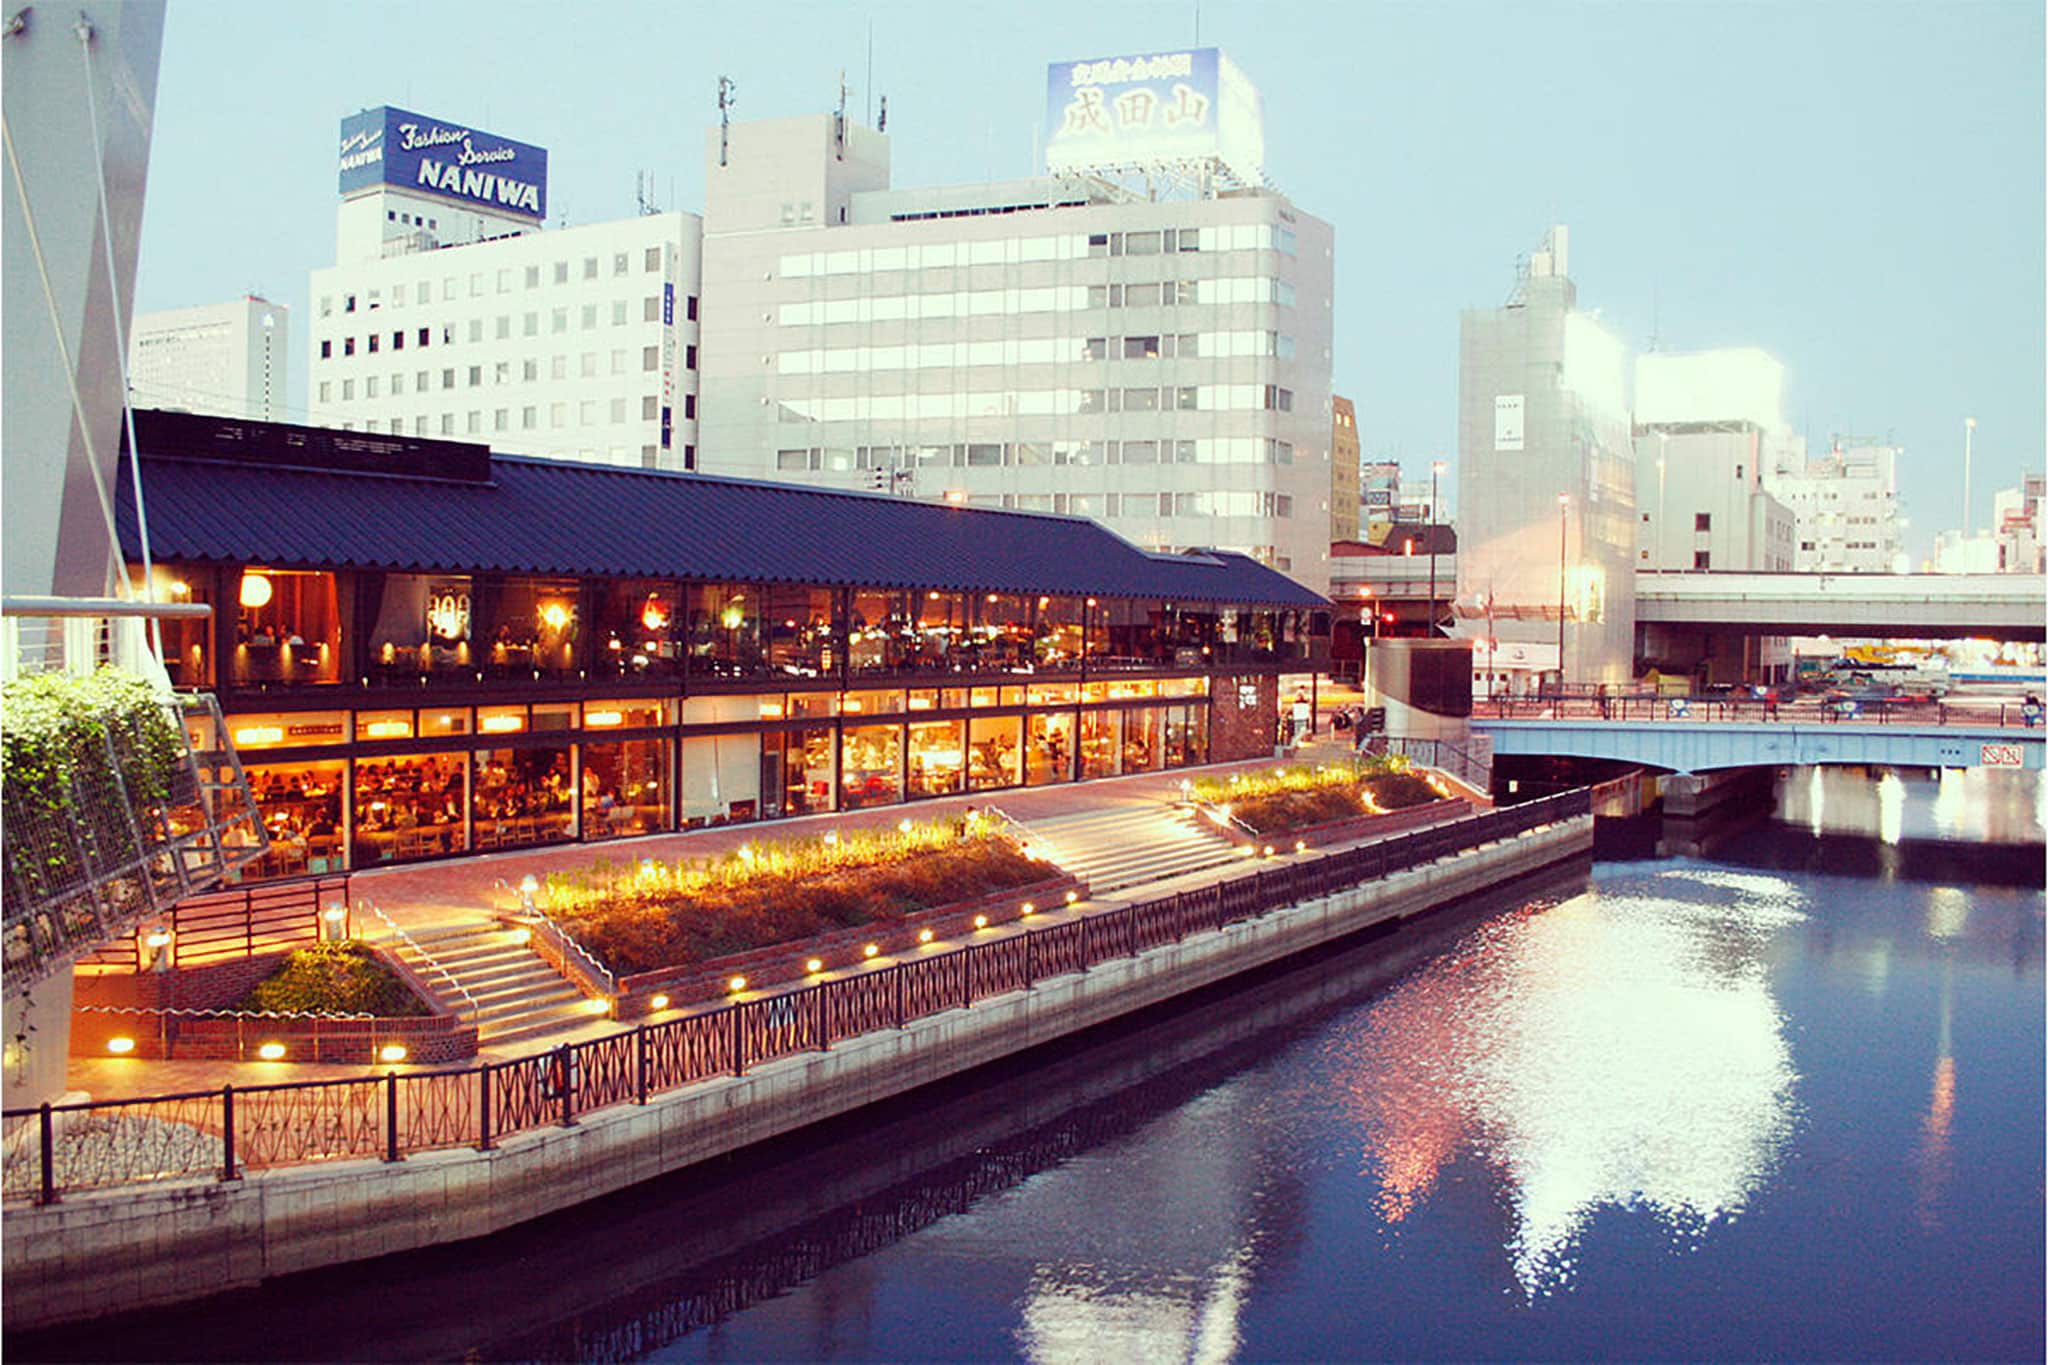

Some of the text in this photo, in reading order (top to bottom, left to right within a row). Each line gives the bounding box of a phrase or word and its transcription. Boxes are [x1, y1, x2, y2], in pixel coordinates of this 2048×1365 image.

[1060, 83, 1207, 136] 成田山
[399, 123, 470, 150] Fashion
[457, 139, 515, 166] Service
[417, 159, 540, 212] NANIWA
